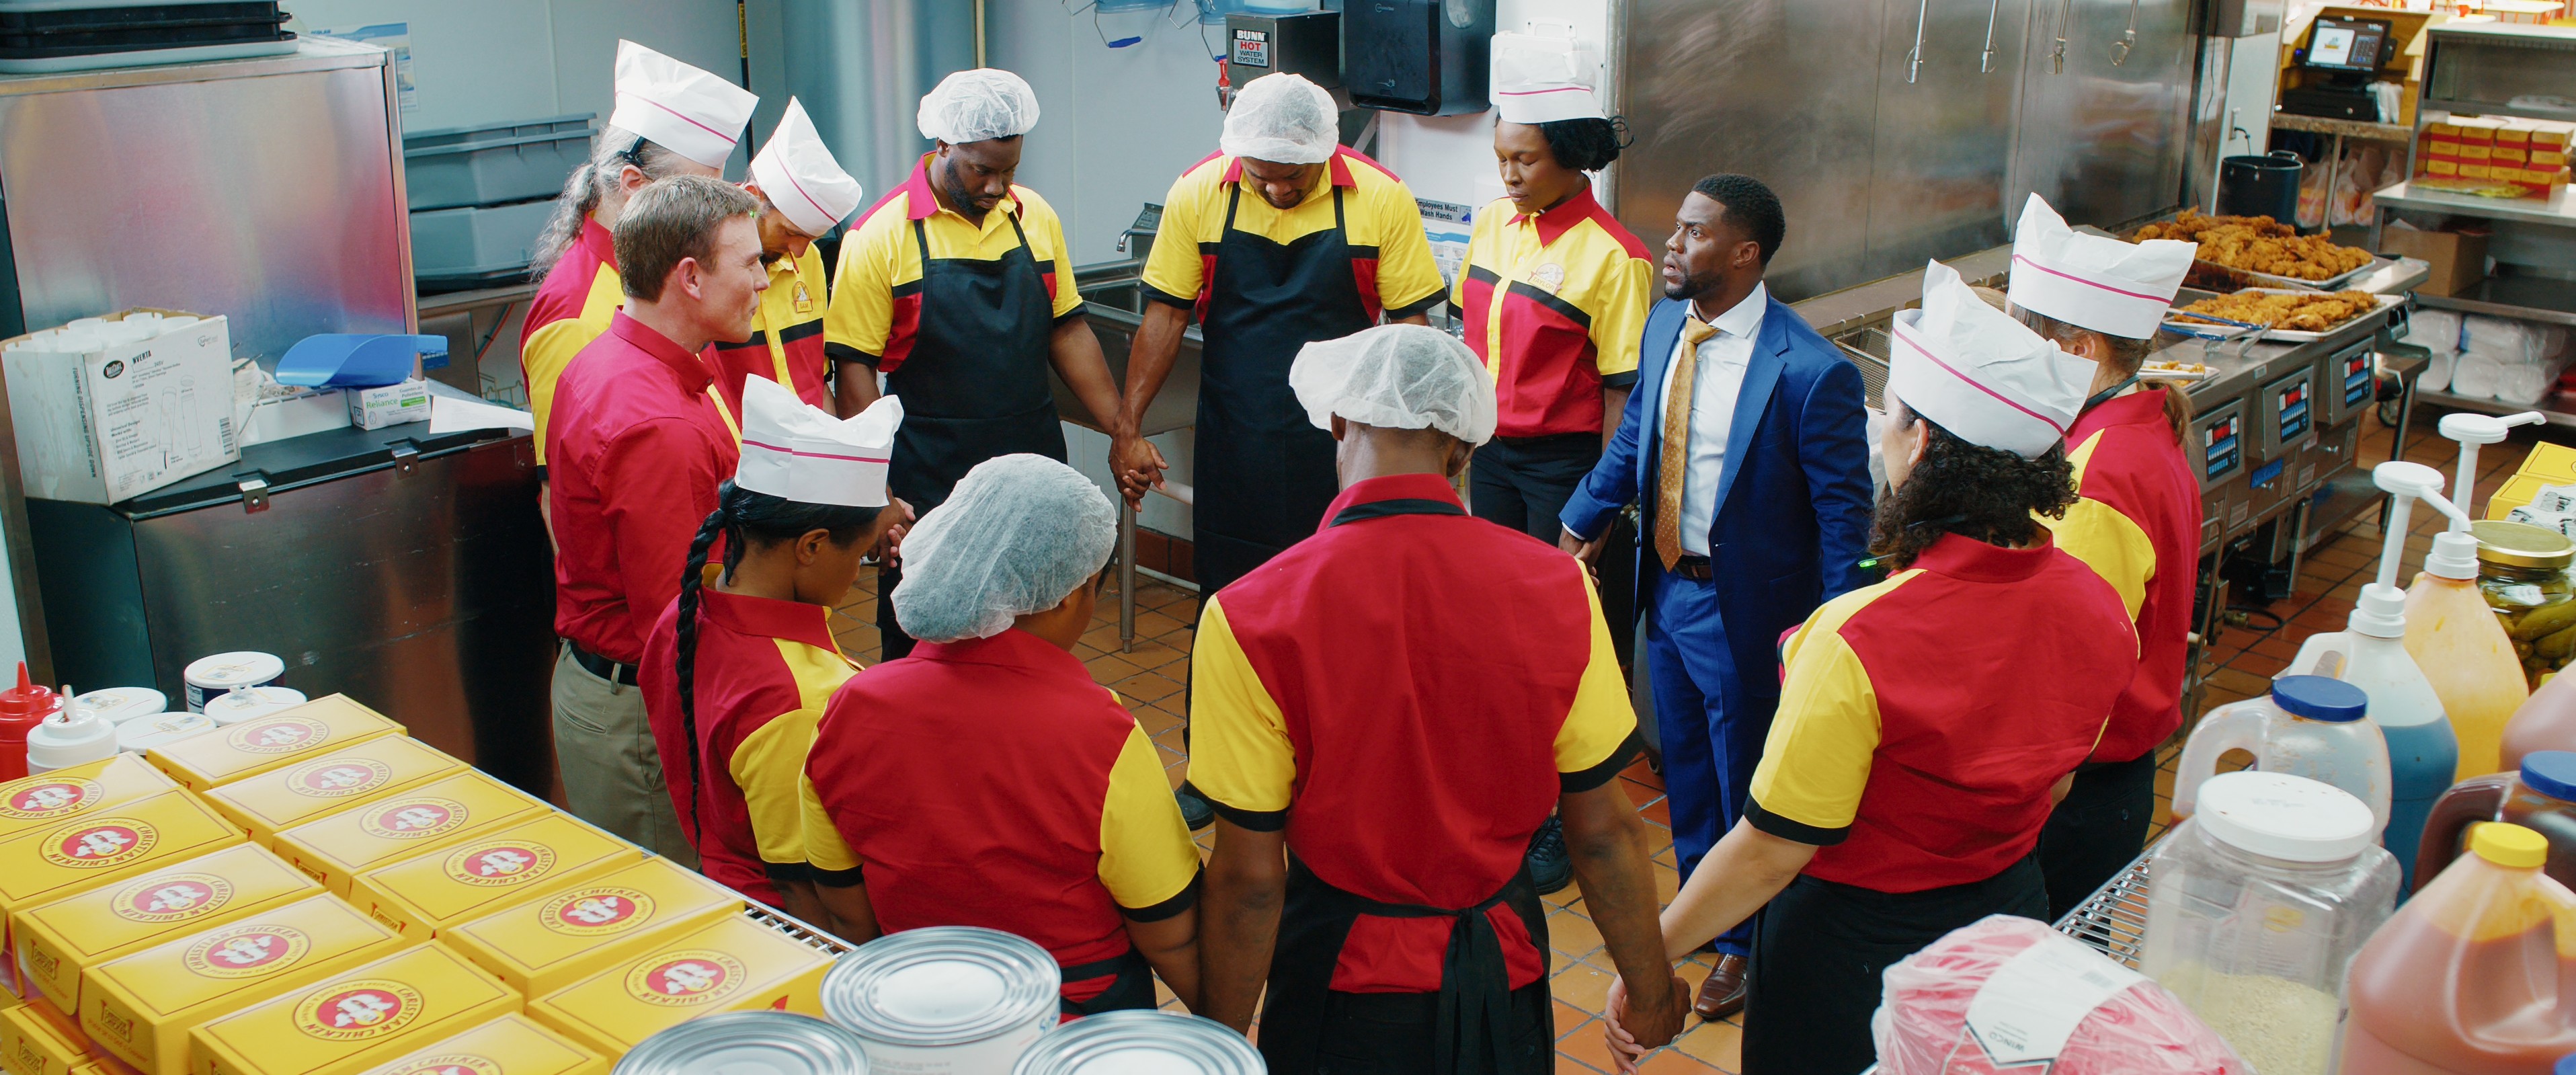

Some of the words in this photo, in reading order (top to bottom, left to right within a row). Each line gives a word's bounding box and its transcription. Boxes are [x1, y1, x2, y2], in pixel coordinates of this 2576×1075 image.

[1237, 30, 1264, 41] BUNN
[1240, 41, 1261, 51] HOT
[1238, 56, 1264, 65] SYSTEM
[1416, 200, 1443, 210] Employees
[1445, 204, 1458, 212] Must
[1420, 208, 1434, 217] Wash
[1435, 212, 1452, 221] Hands
[1533, 276, 1555, 290] TAYLOR
[366, 398, 399, 409] Reliance
[78, 396, 89, 433] DISPENSING
[85, 436, 94, 458] UPSIDE
[89, 459, 97, 478] DOWN
[59, 784, 99, 814] CHRISTIAN
[436, 803, 463, 832] CHRISTIAN
[371, 828, 430, 838] CHICKEN
[114, 826, 154, 862] CHRISTIAN
[47, 853, 109, 866] CHICKEN
[523, 846, 551, 879] CHRISTIAN
[456, 873, 517, 885] CHICKEN
[190, 880, 229, 916] CHRISTIAN
[120, 908, 184, 920] CHICKEN
[545, 895, 577, 928] CHRISTIAN
[581, 889, 645, 899] CHICKEN
[188, 932, 230, 971] CHRISTIAN
[235, 926, 301, 939] CHICKEN
[712, 957, 741, 996] CHRISTIAN
[640, 992, 709, 1004] CHICKEN
[381, 988, 419, 1032] CHRISTIAN
[304, 1023, 375, 1039] CHICKEN
[417, 1056, 489, 1069] CHICKEN
